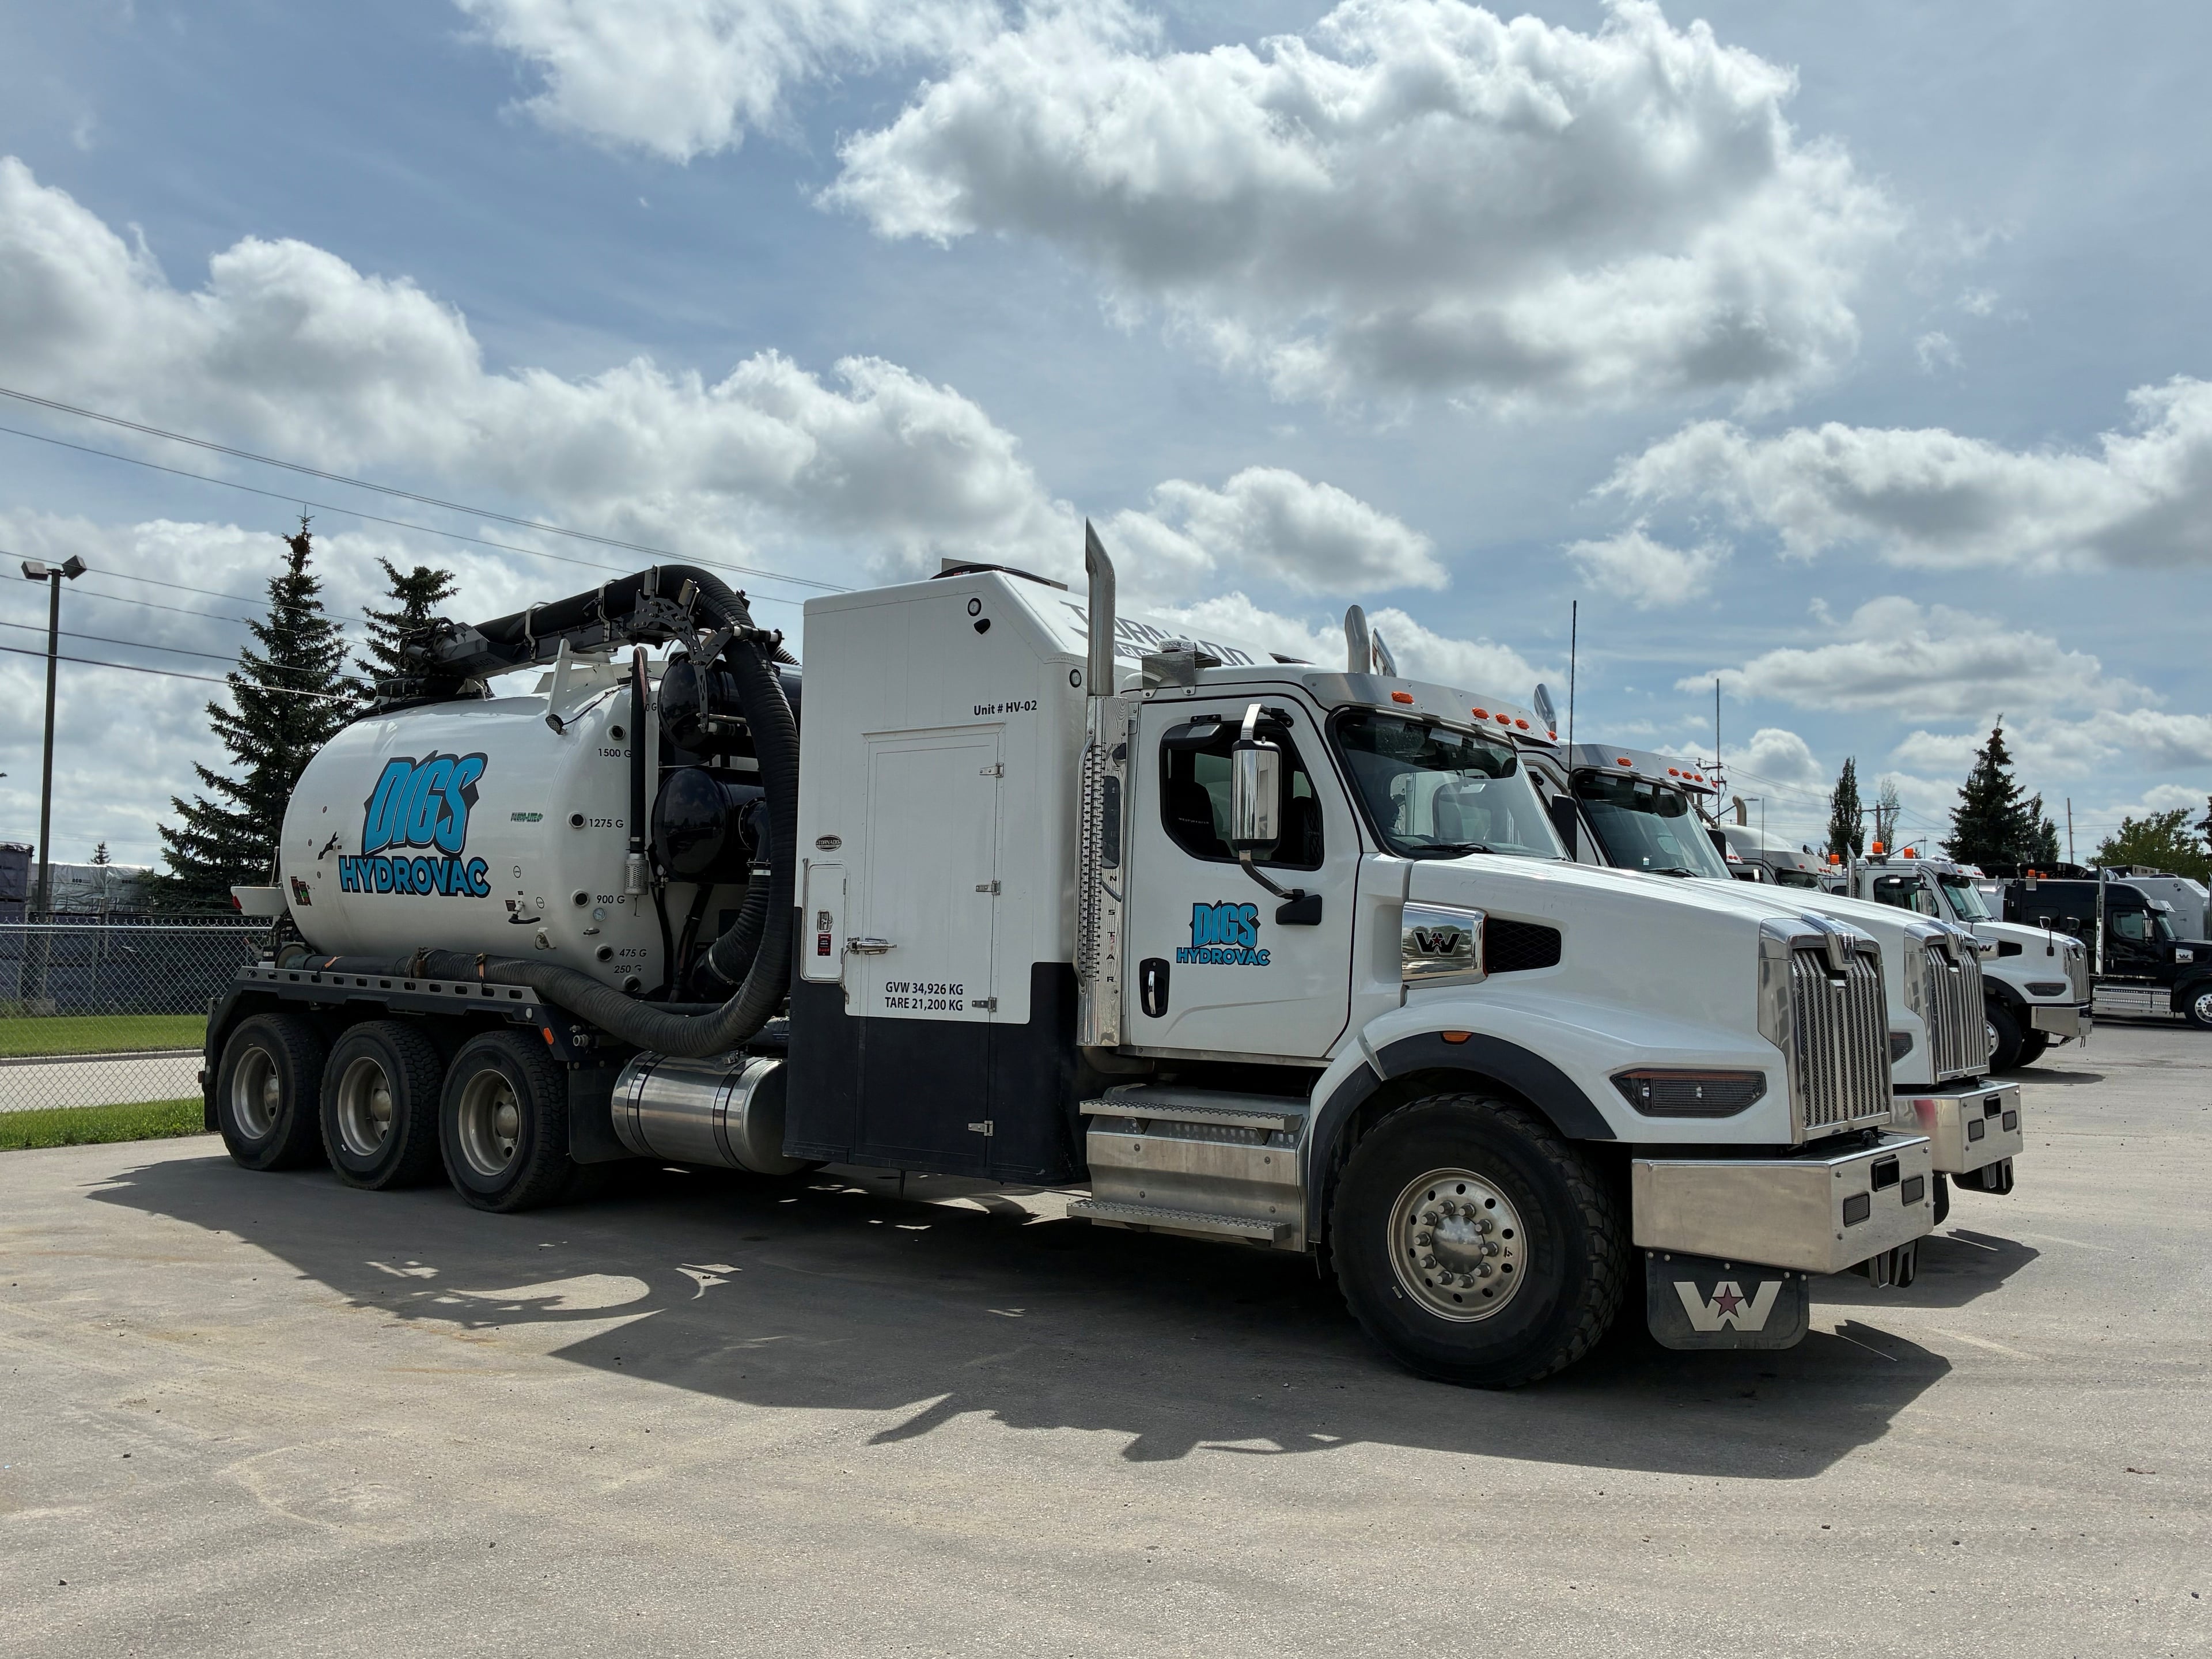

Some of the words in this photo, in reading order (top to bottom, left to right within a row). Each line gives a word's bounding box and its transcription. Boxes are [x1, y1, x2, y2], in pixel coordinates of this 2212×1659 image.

[1059, 600, 1255, 665] TRNDO
[974, 703, 995, 715] Unit
[997, 703, 1003, 714] #
[1006, 700, 1037, 713] HV-02
[598, 748, 621, 757] 1500
[624, 749, 631, 758] G
[362, 751, 488, 857] DIGS
[589, 819, 612, 828] 1275
[615, 819, 624, 828] G
[338, 855, 491, 898] HYDROVAC
[597, 895, 614, 904] 900
[616, 895, 625, 904] G
[1191, 901, 1259, 948] DIGS
[619, 948, 637, 957] 475
[639, 949, 647, 957] G
[1176, 947, 1271, 966] HYDROVAC
[613, 965, 631, 974] 250
[885, 981, 910, 993] GVW
[912, 983, 946, 996] 34,926
[949, 983, 964, 995] KG
[885, 997, 910, 1009] TARE
[911, 998, 946, 1012] 21,200
[949, 999, 963, 1011] KG
